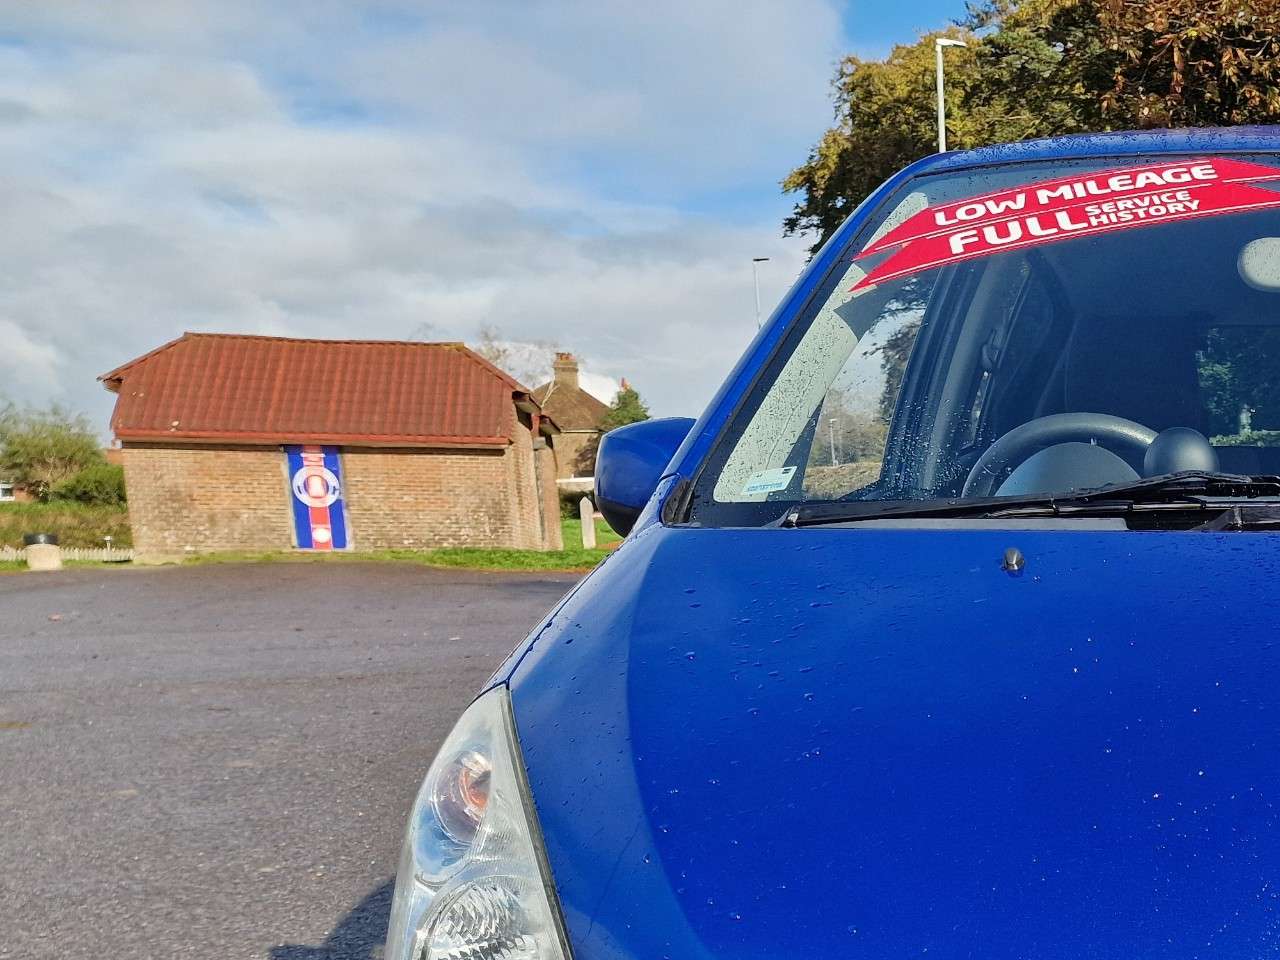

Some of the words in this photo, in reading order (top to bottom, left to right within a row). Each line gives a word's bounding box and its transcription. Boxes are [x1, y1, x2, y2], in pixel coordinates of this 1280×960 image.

[934, 193, 1026, 226] LOW
[1036, 164, 1218, 205] MILEAGE
[1084, 190, 1192, 217] SERVICE
[1088, 199, 1200, 228] HISTORY
[948, 210, 1089, 255] FULL
